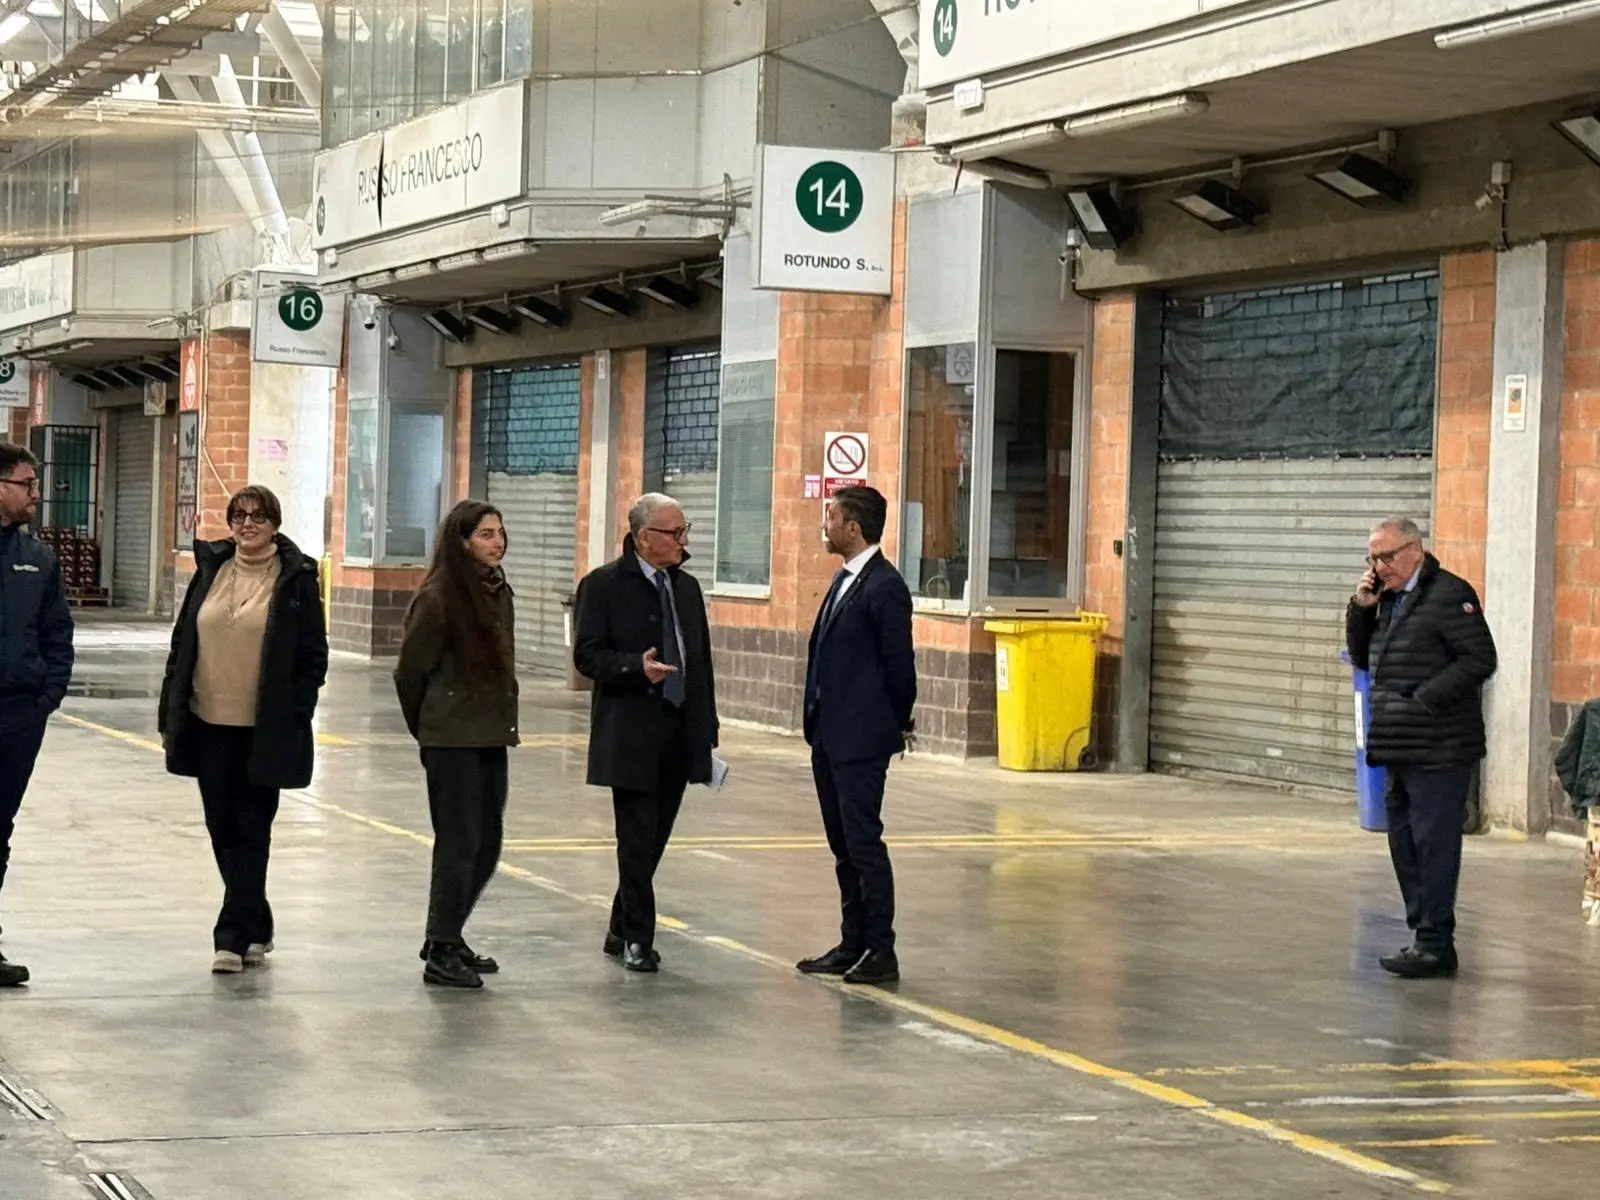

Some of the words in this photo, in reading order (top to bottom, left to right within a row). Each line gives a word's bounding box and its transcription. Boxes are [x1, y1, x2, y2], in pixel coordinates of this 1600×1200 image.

[937, 4, 953, 43] 14
[400, 132, 483, 193] FRANCESCO
[809, 178, 850, 217] 14
[783, 253, 851, 270] ROTUNDO
[856, 258, 869, 271] S.
[285, 295, 316, 321] 16
